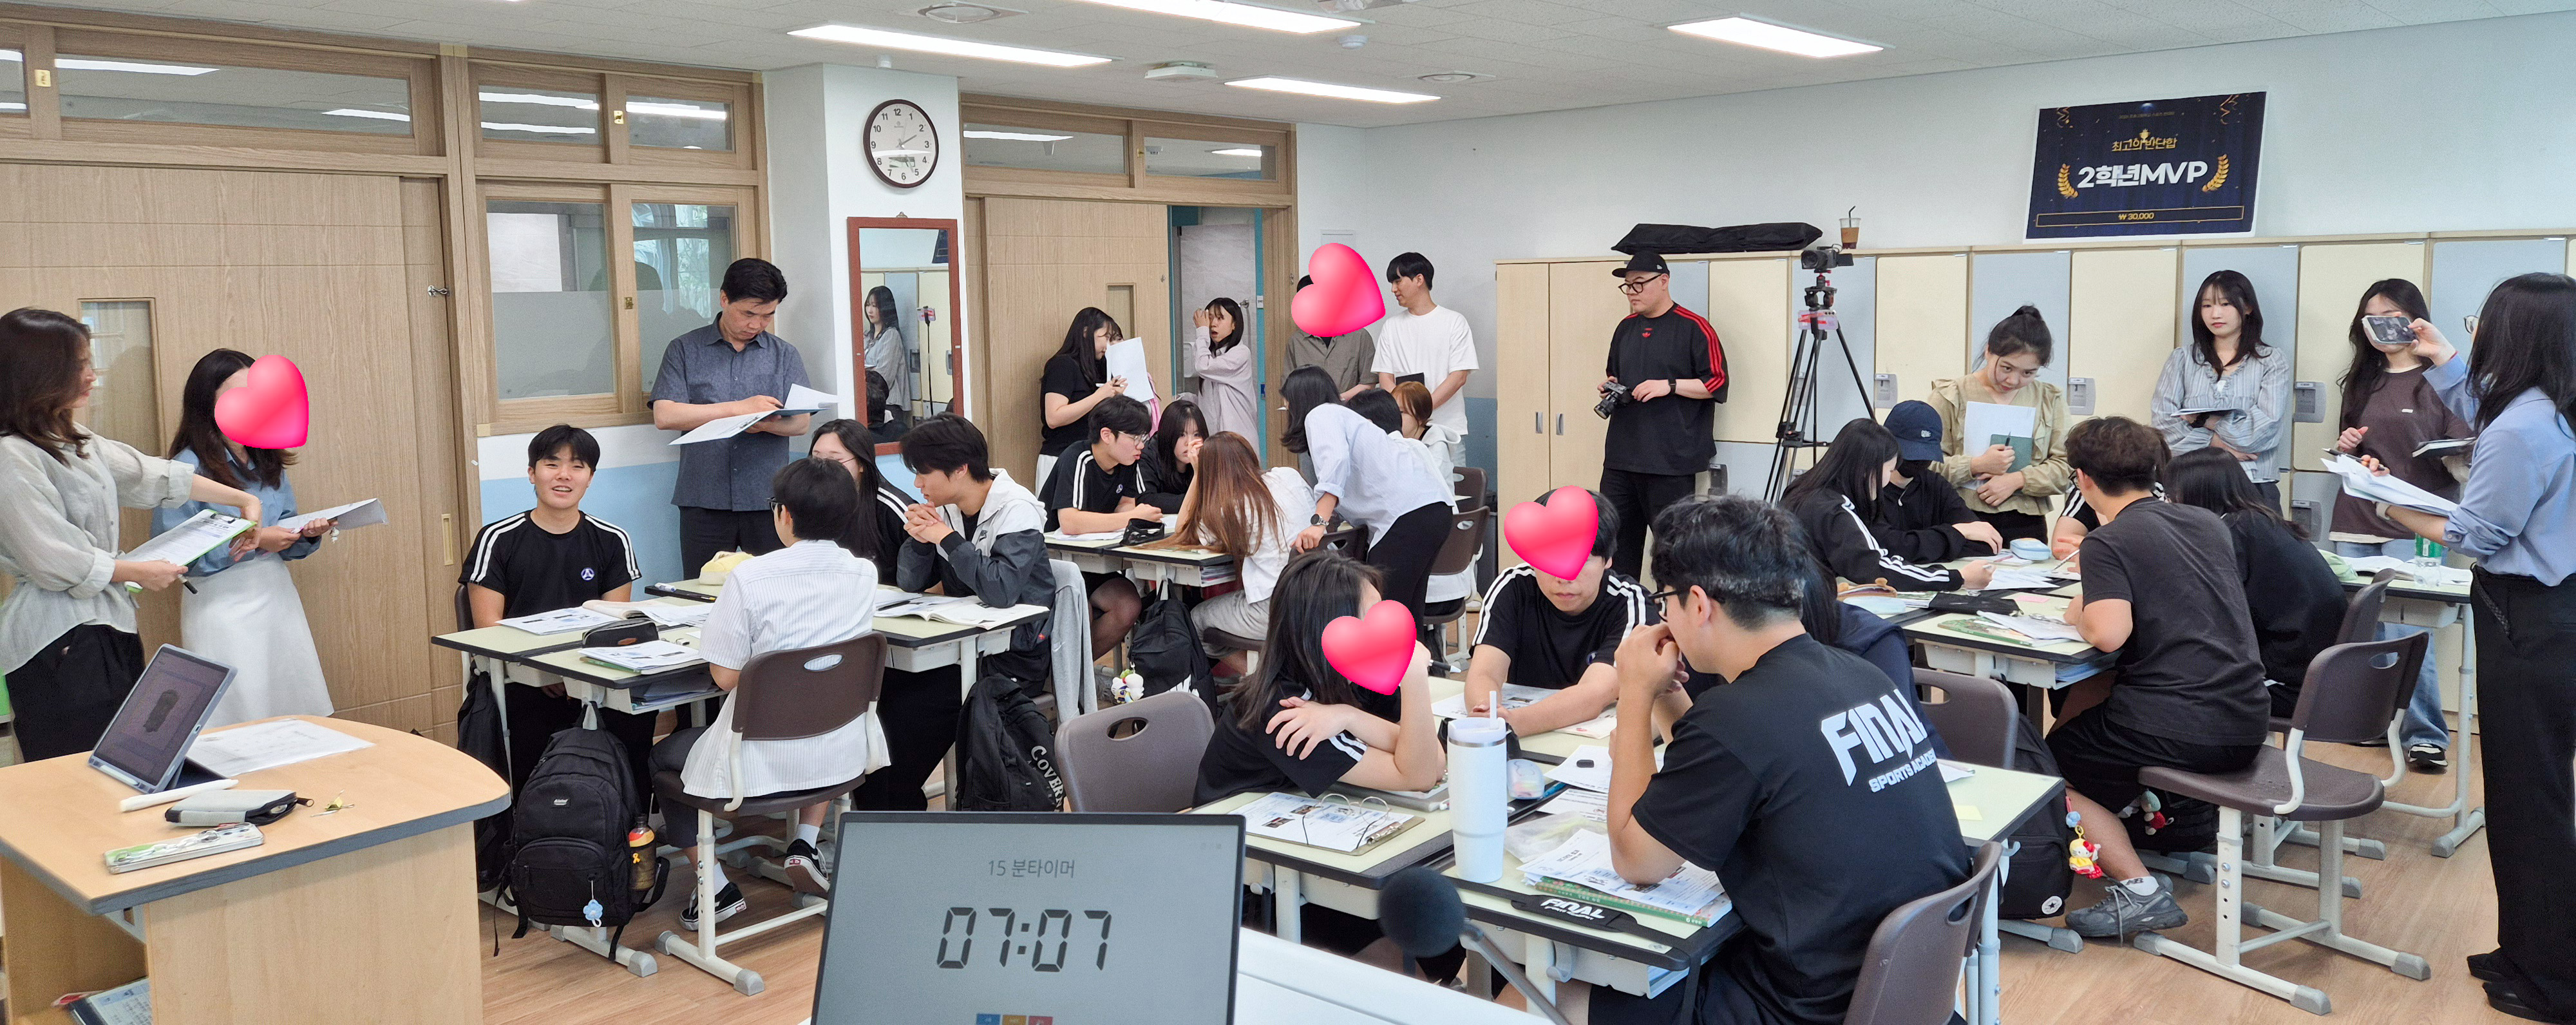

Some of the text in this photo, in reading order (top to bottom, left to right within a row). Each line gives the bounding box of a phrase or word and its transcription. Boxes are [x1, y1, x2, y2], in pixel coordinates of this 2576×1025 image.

[2077, 161, 2208, 188] 2학년MVP
[1821, 688, 1928, 787] FINAL
[1869, 747, 1937, 792] SPORTS ACADE
[988, 859, 1075, 879] 15 분타이머
[1540, 898, 1605, 919] FINAL
[936, 907, 1112, 972] 07:07
